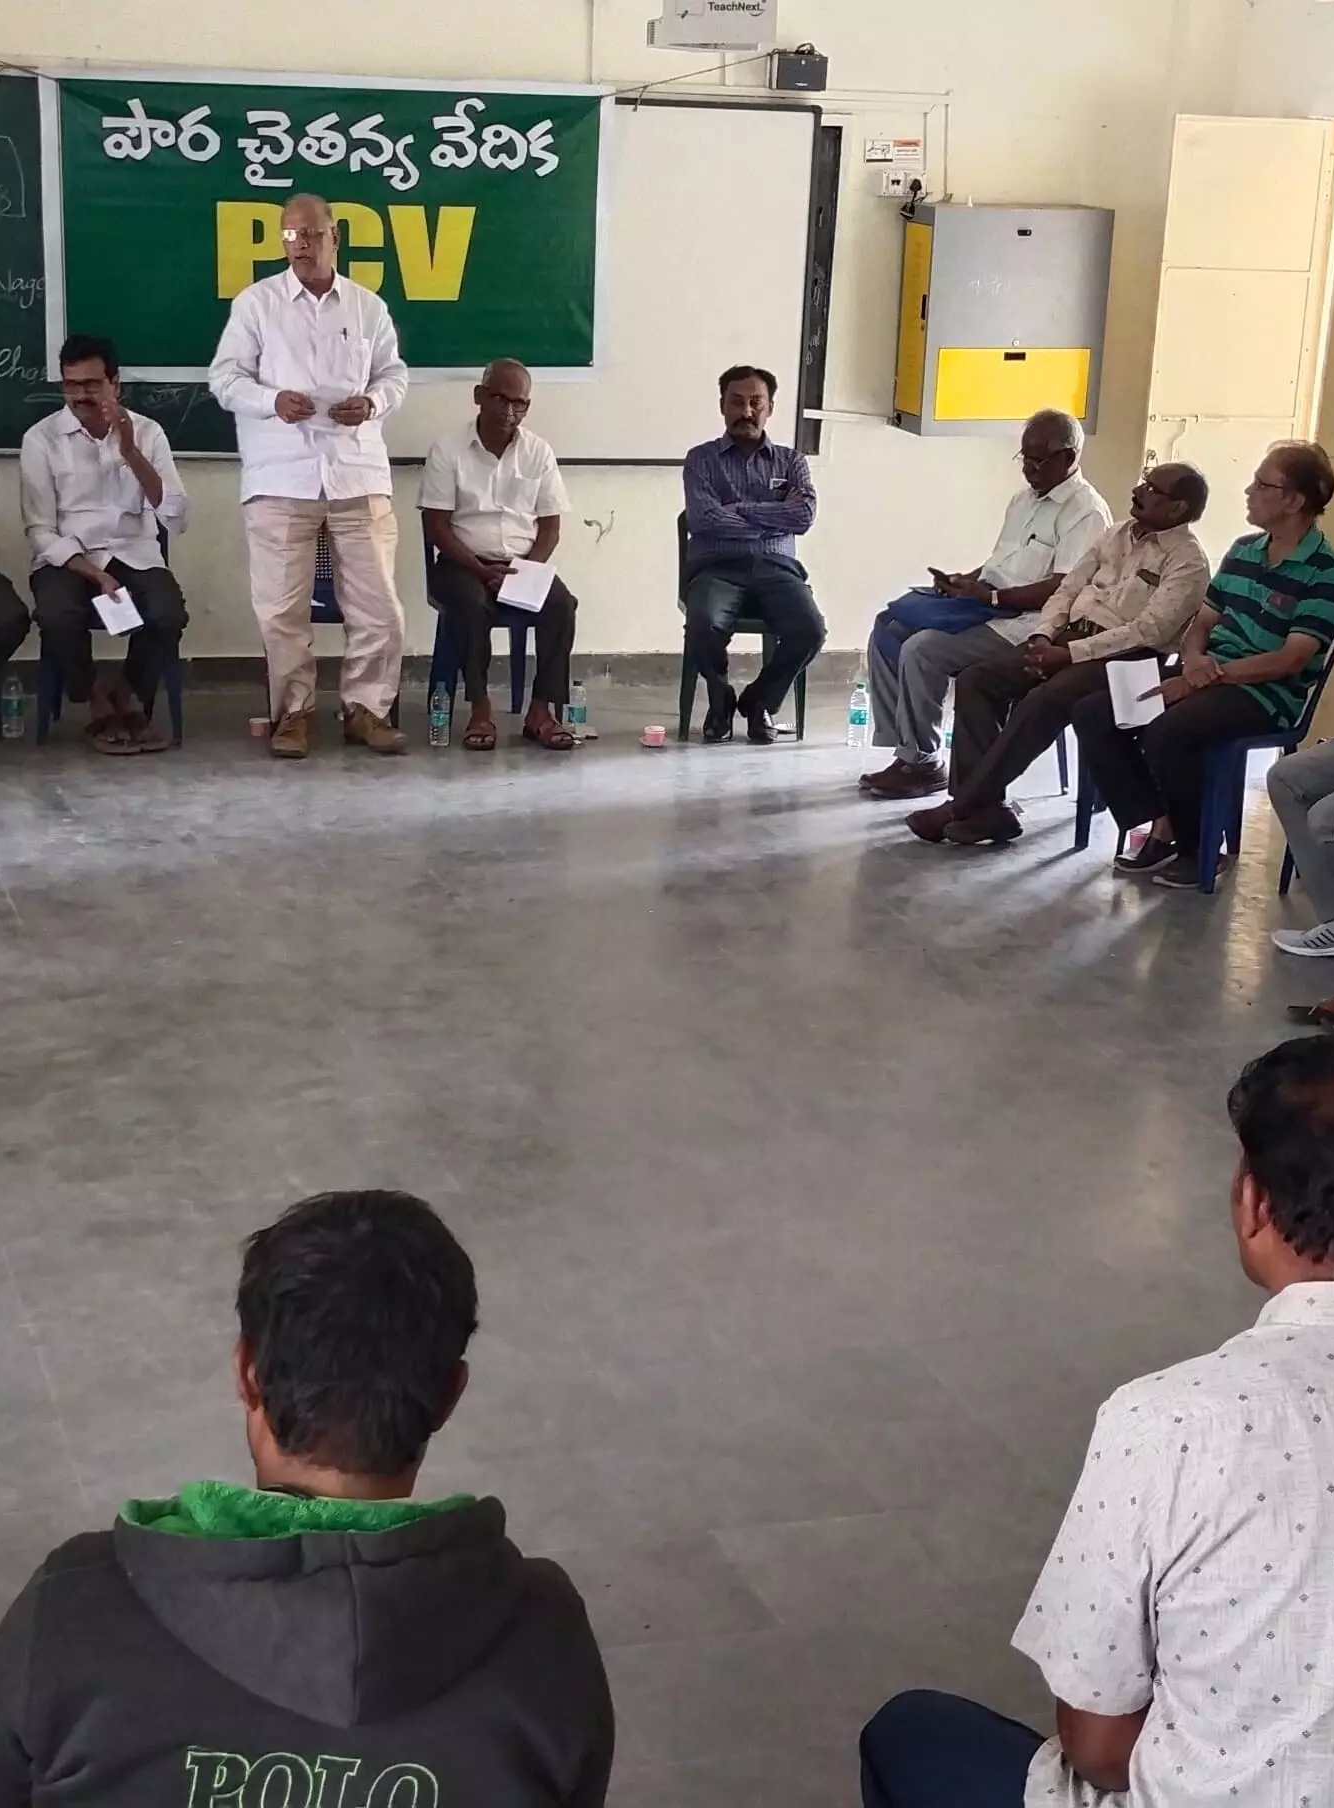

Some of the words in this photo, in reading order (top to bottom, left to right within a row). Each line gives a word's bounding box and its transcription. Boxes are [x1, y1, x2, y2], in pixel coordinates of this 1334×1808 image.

[707, 1, 765, 12] TeachNext
[101, 98, 220, 162] పౌర
[238, 110, 420, 192] చైతన్య
[430, 98, 560, 177] వేదిక
[185, 1750, 439, 1808] POLO
